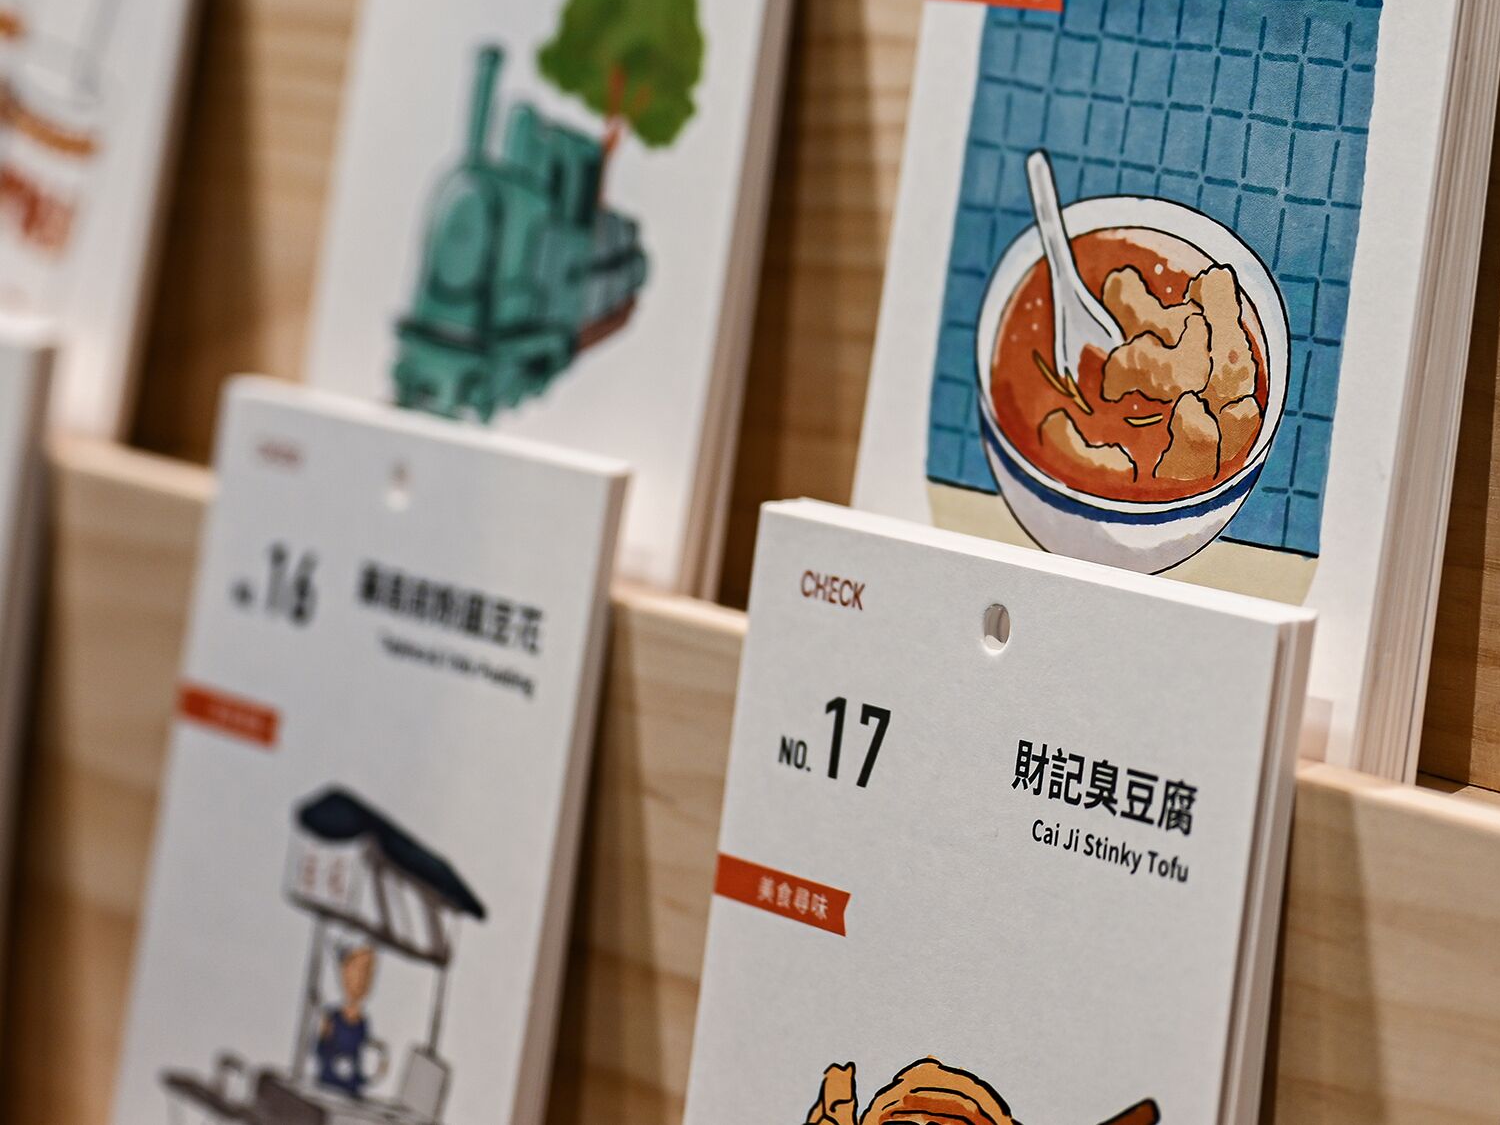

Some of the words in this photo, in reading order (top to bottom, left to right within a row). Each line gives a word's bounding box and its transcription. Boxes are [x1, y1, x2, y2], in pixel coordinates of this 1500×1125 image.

[800, 570, 866, 611] CHECK
[778, 736, 811, 773] NO.
[825, 696, 892, 788] 17
[1011, 739, 1198, 837] 財記臭豆腐
[1032, 819, 1060, 847] Cai
[1063, 828, 1081, 852] Ji
[1083, 833, 1142, 875] Stinky
[1148, 850, 1190, 883] Tofu
[757, 875, 829, 921] 美食尋味
